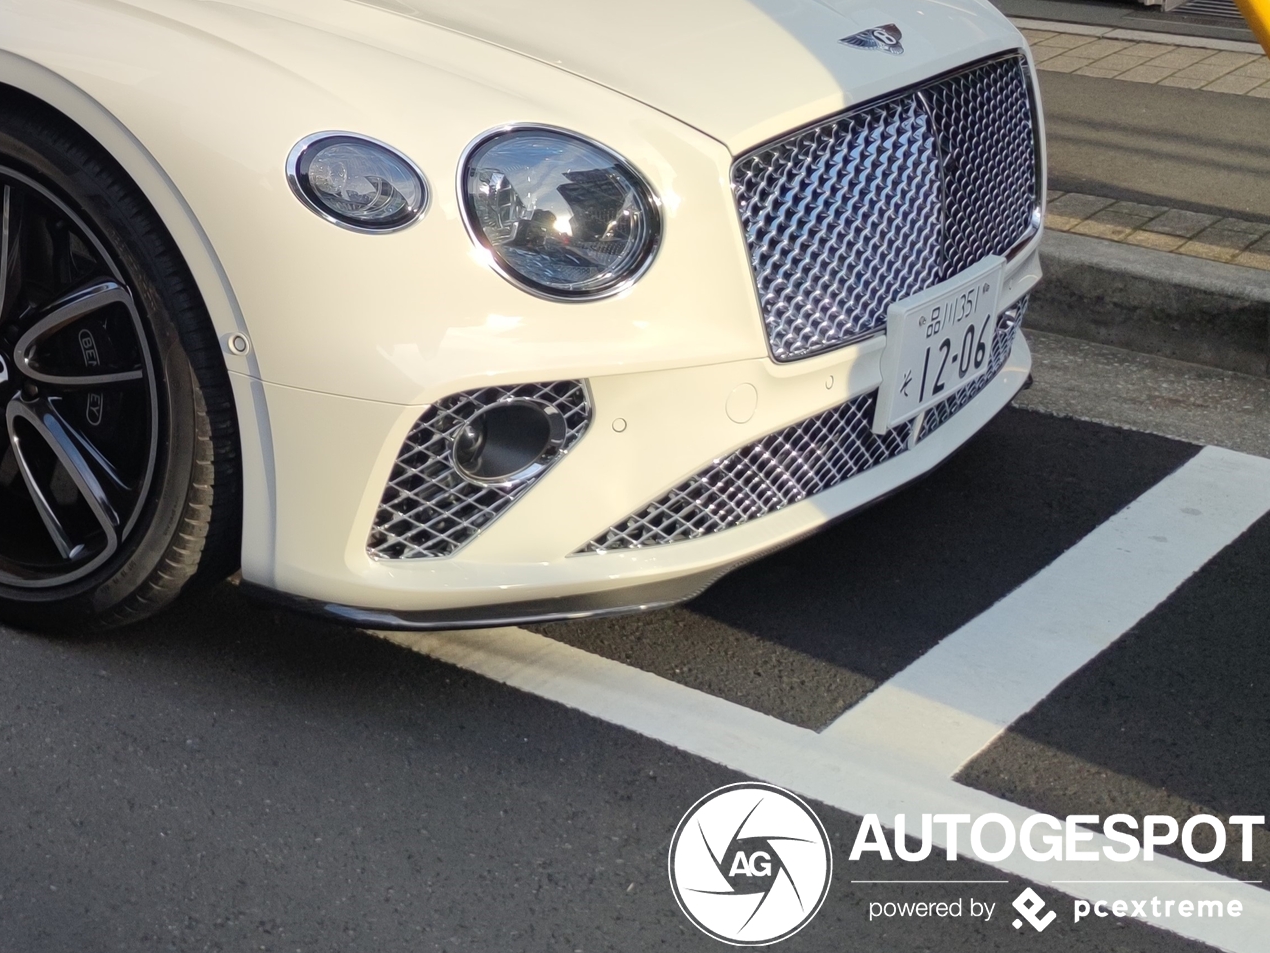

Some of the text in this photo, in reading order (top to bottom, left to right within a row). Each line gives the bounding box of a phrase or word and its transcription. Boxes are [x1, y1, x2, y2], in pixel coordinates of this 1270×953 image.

[926, 287, 980, 339] 品川 351
[918, 314, 990, 403] 12-06
